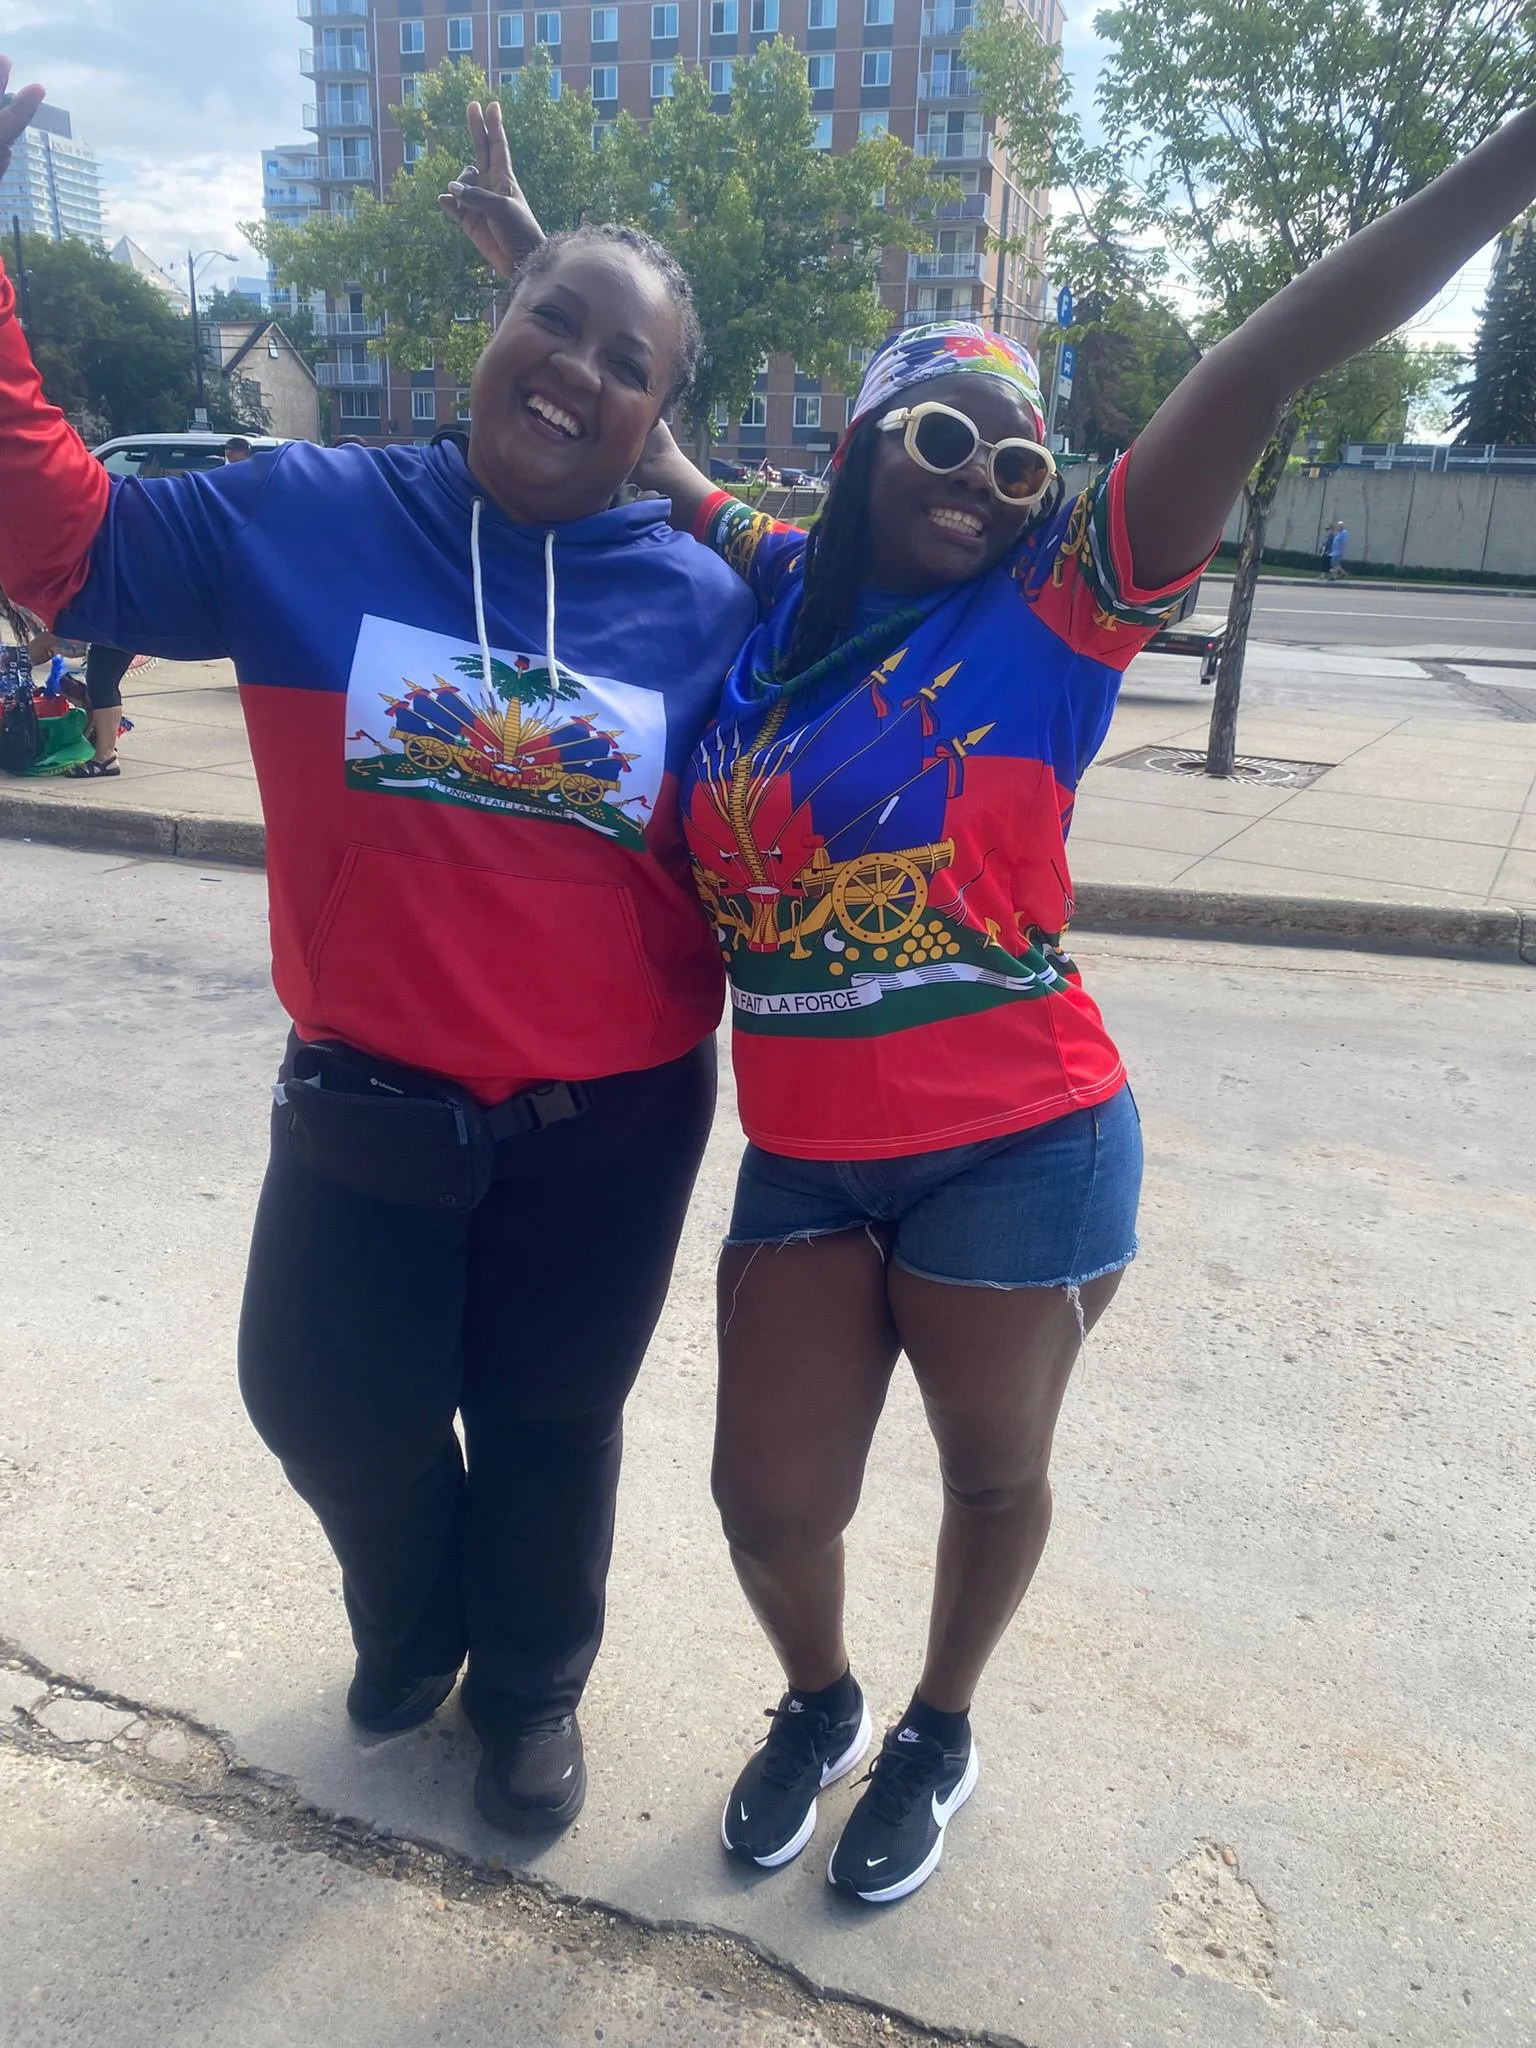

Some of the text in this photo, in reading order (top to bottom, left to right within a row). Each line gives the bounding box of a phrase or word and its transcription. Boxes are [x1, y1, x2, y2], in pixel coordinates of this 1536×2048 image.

[740, 993, 763, 1014] FAIT
[766, 997, 791, 1014] LA
[794, 990, 863, 1012] FORCE
